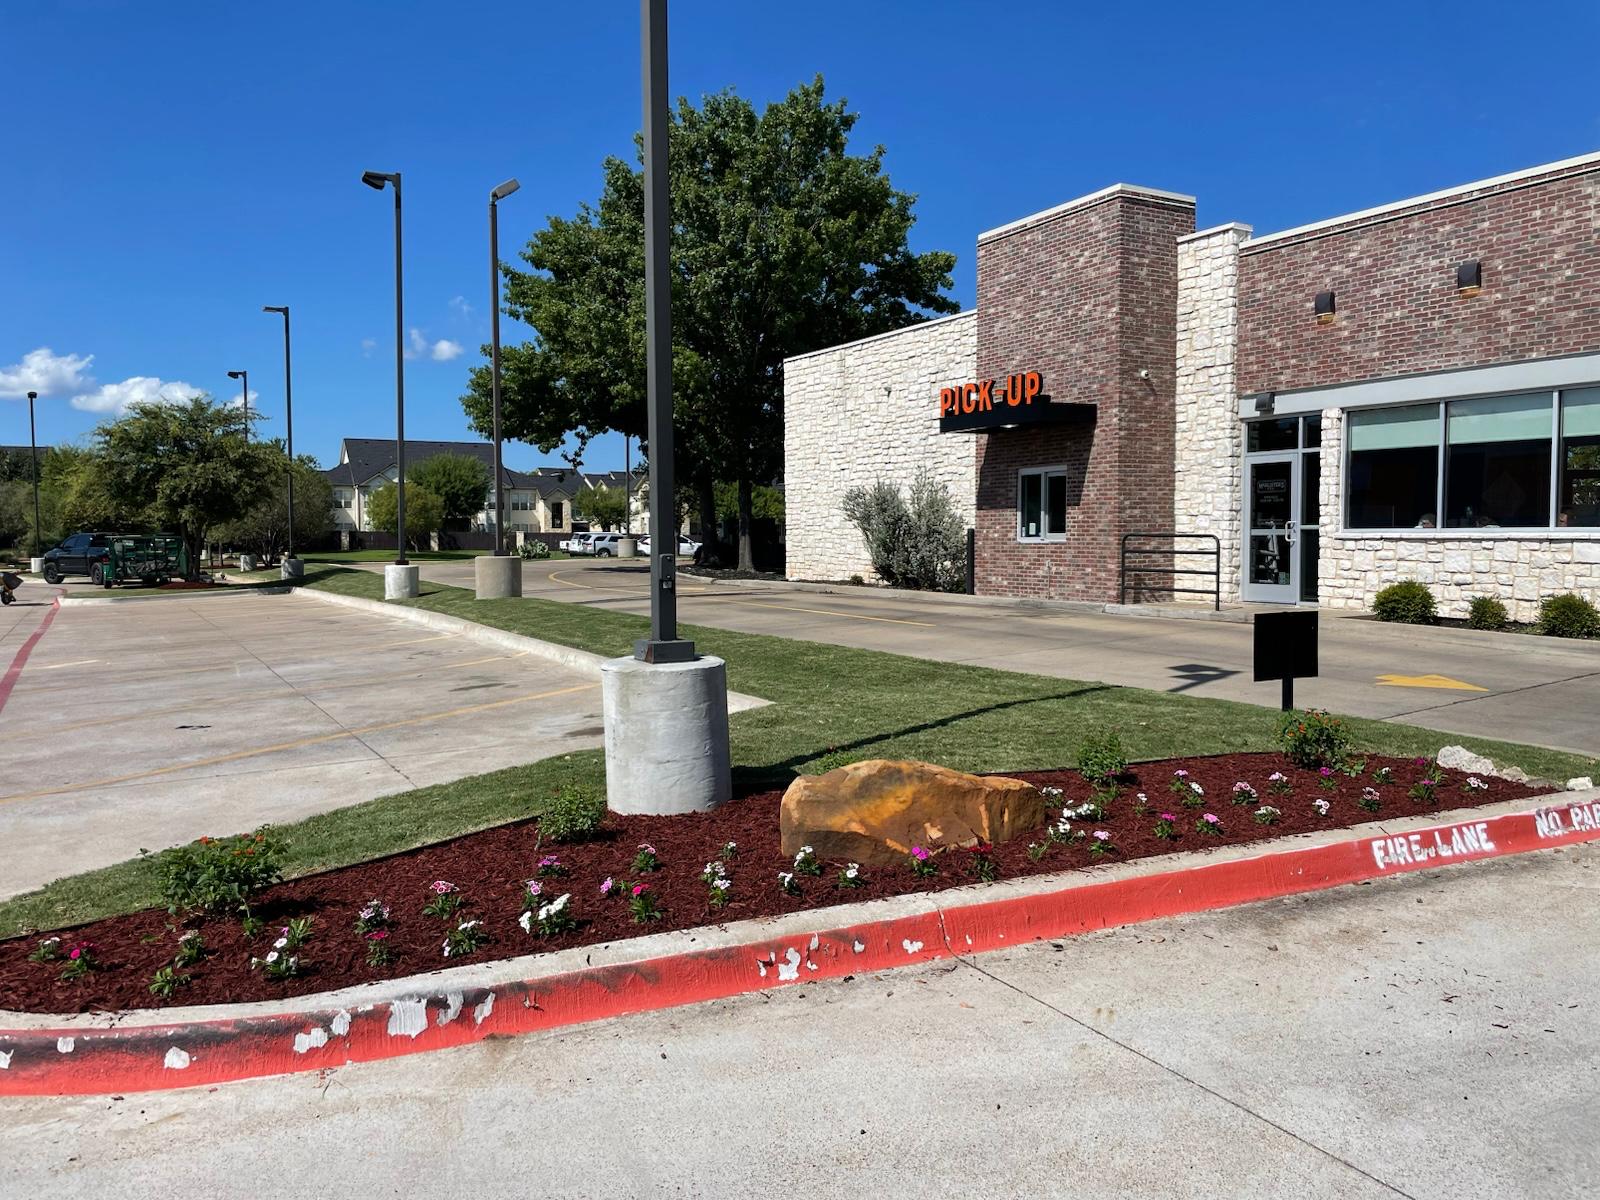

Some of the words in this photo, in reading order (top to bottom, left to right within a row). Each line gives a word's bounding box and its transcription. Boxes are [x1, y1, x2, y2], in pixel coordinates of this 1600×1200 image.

[940, 371, 1040, 418] PICK-UP
[1372, 835, 1421, 869] FIRE
[1433, 823, 1495, 857] LANE
[1534, 810, 1563, 839] NO
